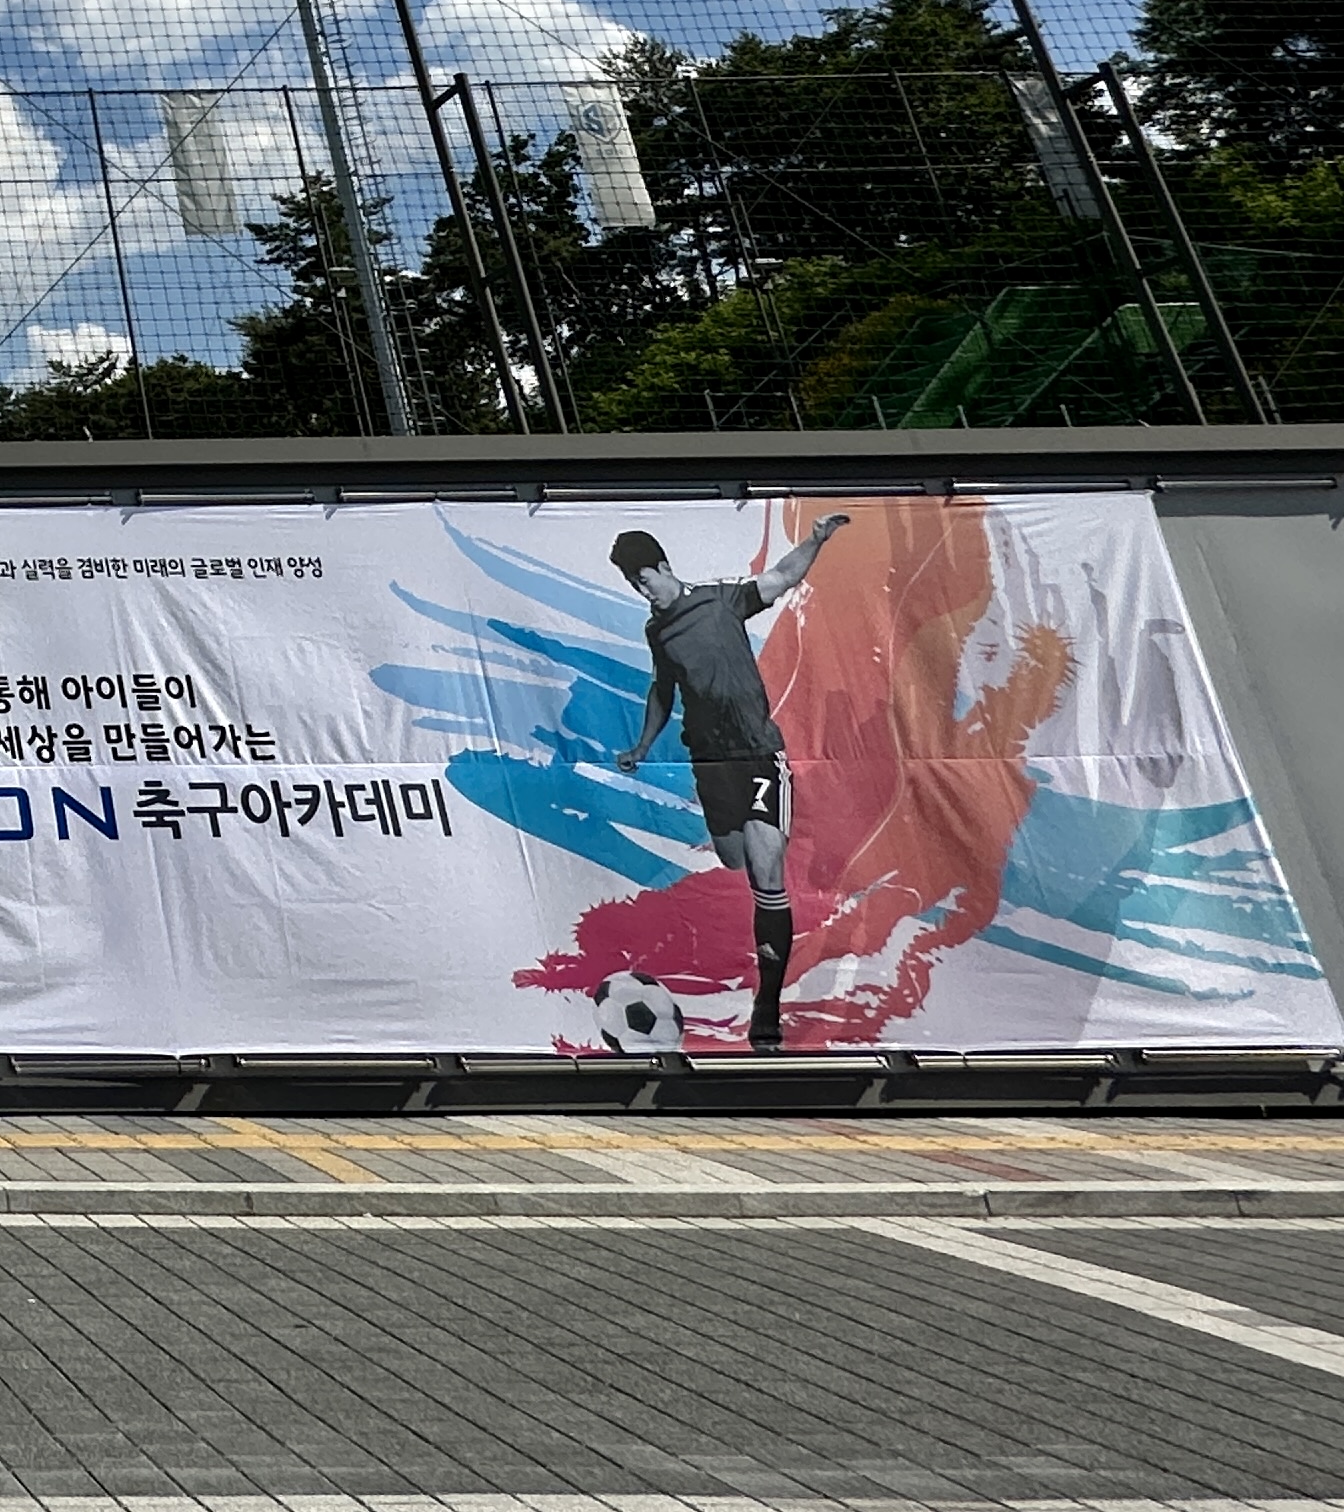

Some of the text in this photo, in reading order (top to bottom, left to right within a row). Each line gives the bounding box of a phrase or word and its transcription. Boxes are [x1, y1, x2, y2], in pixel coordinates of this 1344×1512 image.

[21, 557, 73, 581] 실력을
[76, 557, 128, 580] 겸비한
[133, 557, 186, 579] 미래의
[190, 557, 244, 580] 글로벌
[246, 557, 284, 579] 인재
[286, 557, 323, 579] 양성
[61, 674, 198, 712] 아이들이
[103, 723, 277, 762] 만들어가는
[752, 777, 771, 800] 7
[132, 779, 453, 840] 축구아카데미
